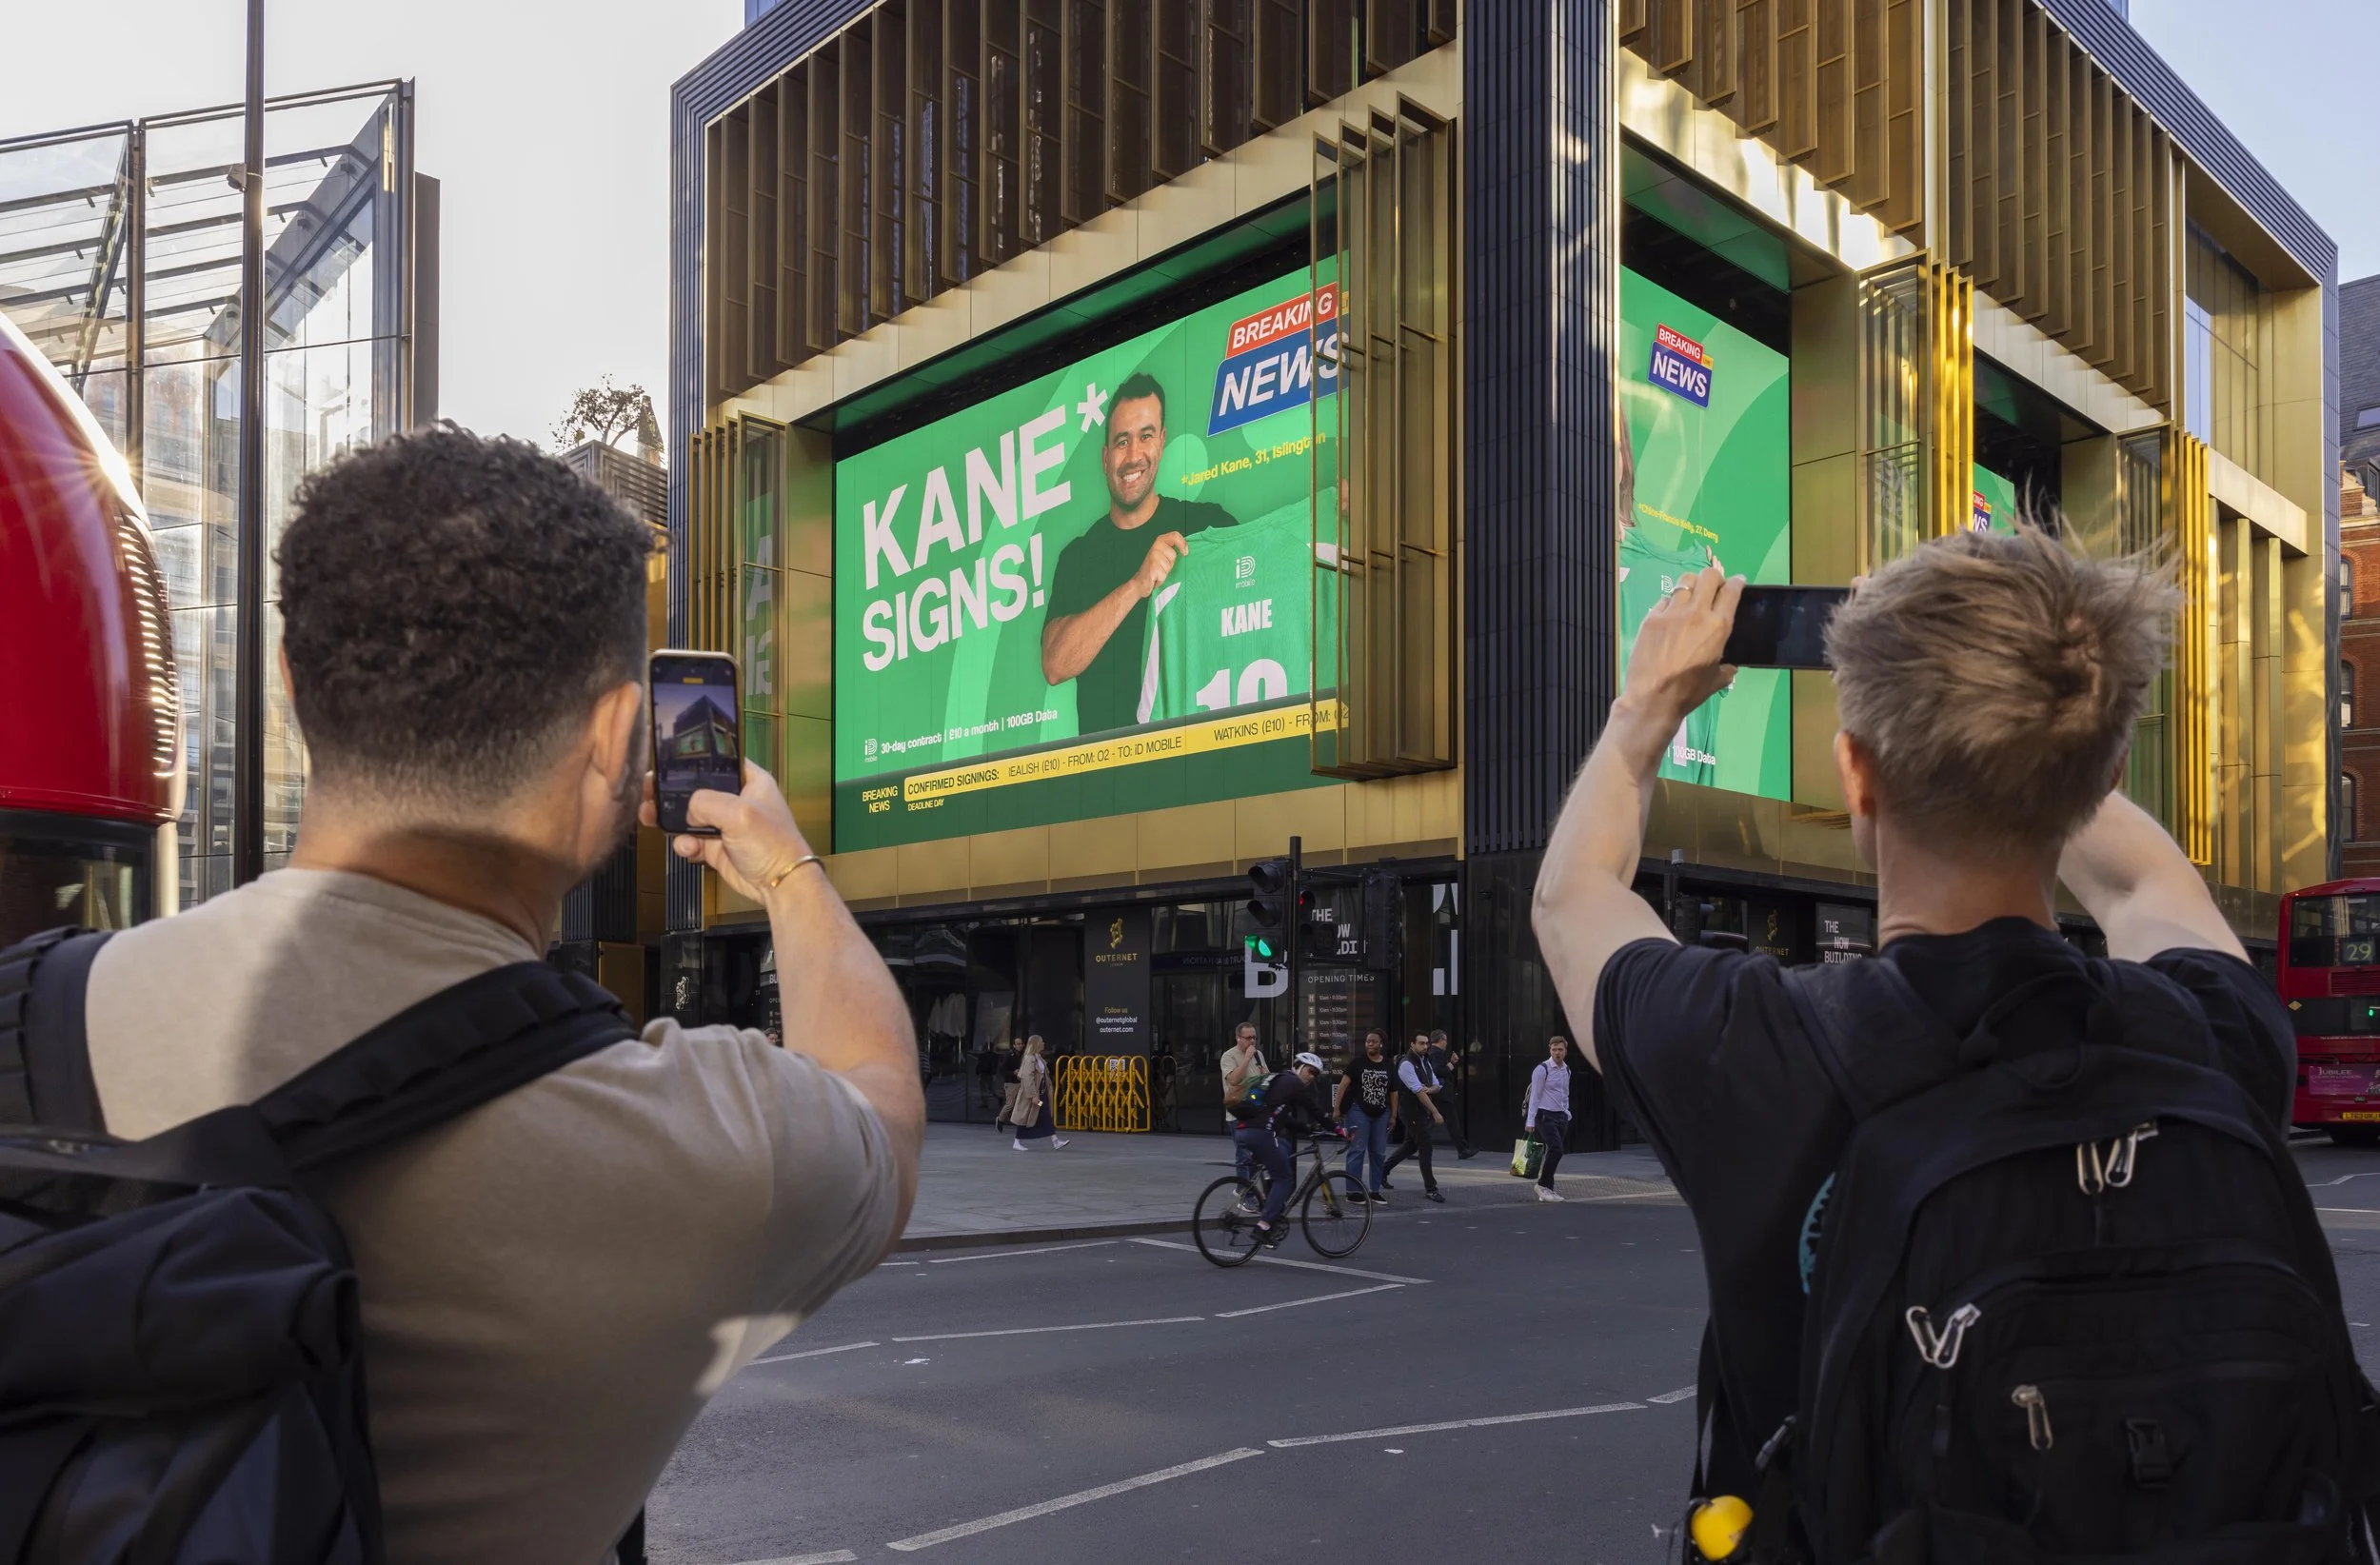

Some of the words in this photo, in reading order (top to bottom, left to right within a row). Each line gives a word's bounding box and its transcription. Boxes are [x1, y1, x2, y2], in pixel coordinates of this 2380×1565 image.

[1232, 292, 1333, 349] BREAKING
[1658, 328, 1701, 359] BREAKING
[1219, 331, 1349, 417] NEWS
[1653, 351, 1707, 398] NEWS
[1220, 457, 1253, 476] Kane,
[1255, 449, 1270, 465] 31,
[1273, 432, 1326, 459] Islingtn
[863, 532, 1044, 672] SIGNS!
[1221, 598, 1273, 637] KANE
[881, 740, 906, 755] 30-day
[907, 733, 942, 748] contract
[949, 726, 962, 740] £10
[963, 728, 969, 737] a
[971, 720, 999, 736] month
[1006, 712, 1034, 728] 100GB
[1036, 708, 1058, 723] Data
[1041, 758, 1061, 773] (£10)
[1067, 752, 1095, 767] FROM:
[1118, 745, 1133, 759] TO:
[1146, 736, 1182, 753] MOBILE
[1214, 723, 1259, 742] WATKINS
[1261, 717, 1285, 736] (£10)
[1697, 750, 1716, 765] Data
[907, 777, 955, 795] CONFIRMED
[957, 769, 1000, 786] SIGNINGS:
[862, 785, 899, 802] BREAKING
[868, 800, 890, 813] NEWS
[907, 800, 933, 812] DEADLINE
[934, 798, 944, 808] DAY
[1824, 920, 1839, 934] THE
[1834, 936, 1850, 949] NOW
[1096, 953, 1138, 962] OUTERNET
[2347, 943, 2371, 961] 29
[1307, 975, 1346, 983] OPENING
[1348, 974, 1375, 982] TIMES
[1096, 1016, 1138, 1024] @outernetglobal
[2317, 1066, 2352, 1076] JUBILEE
